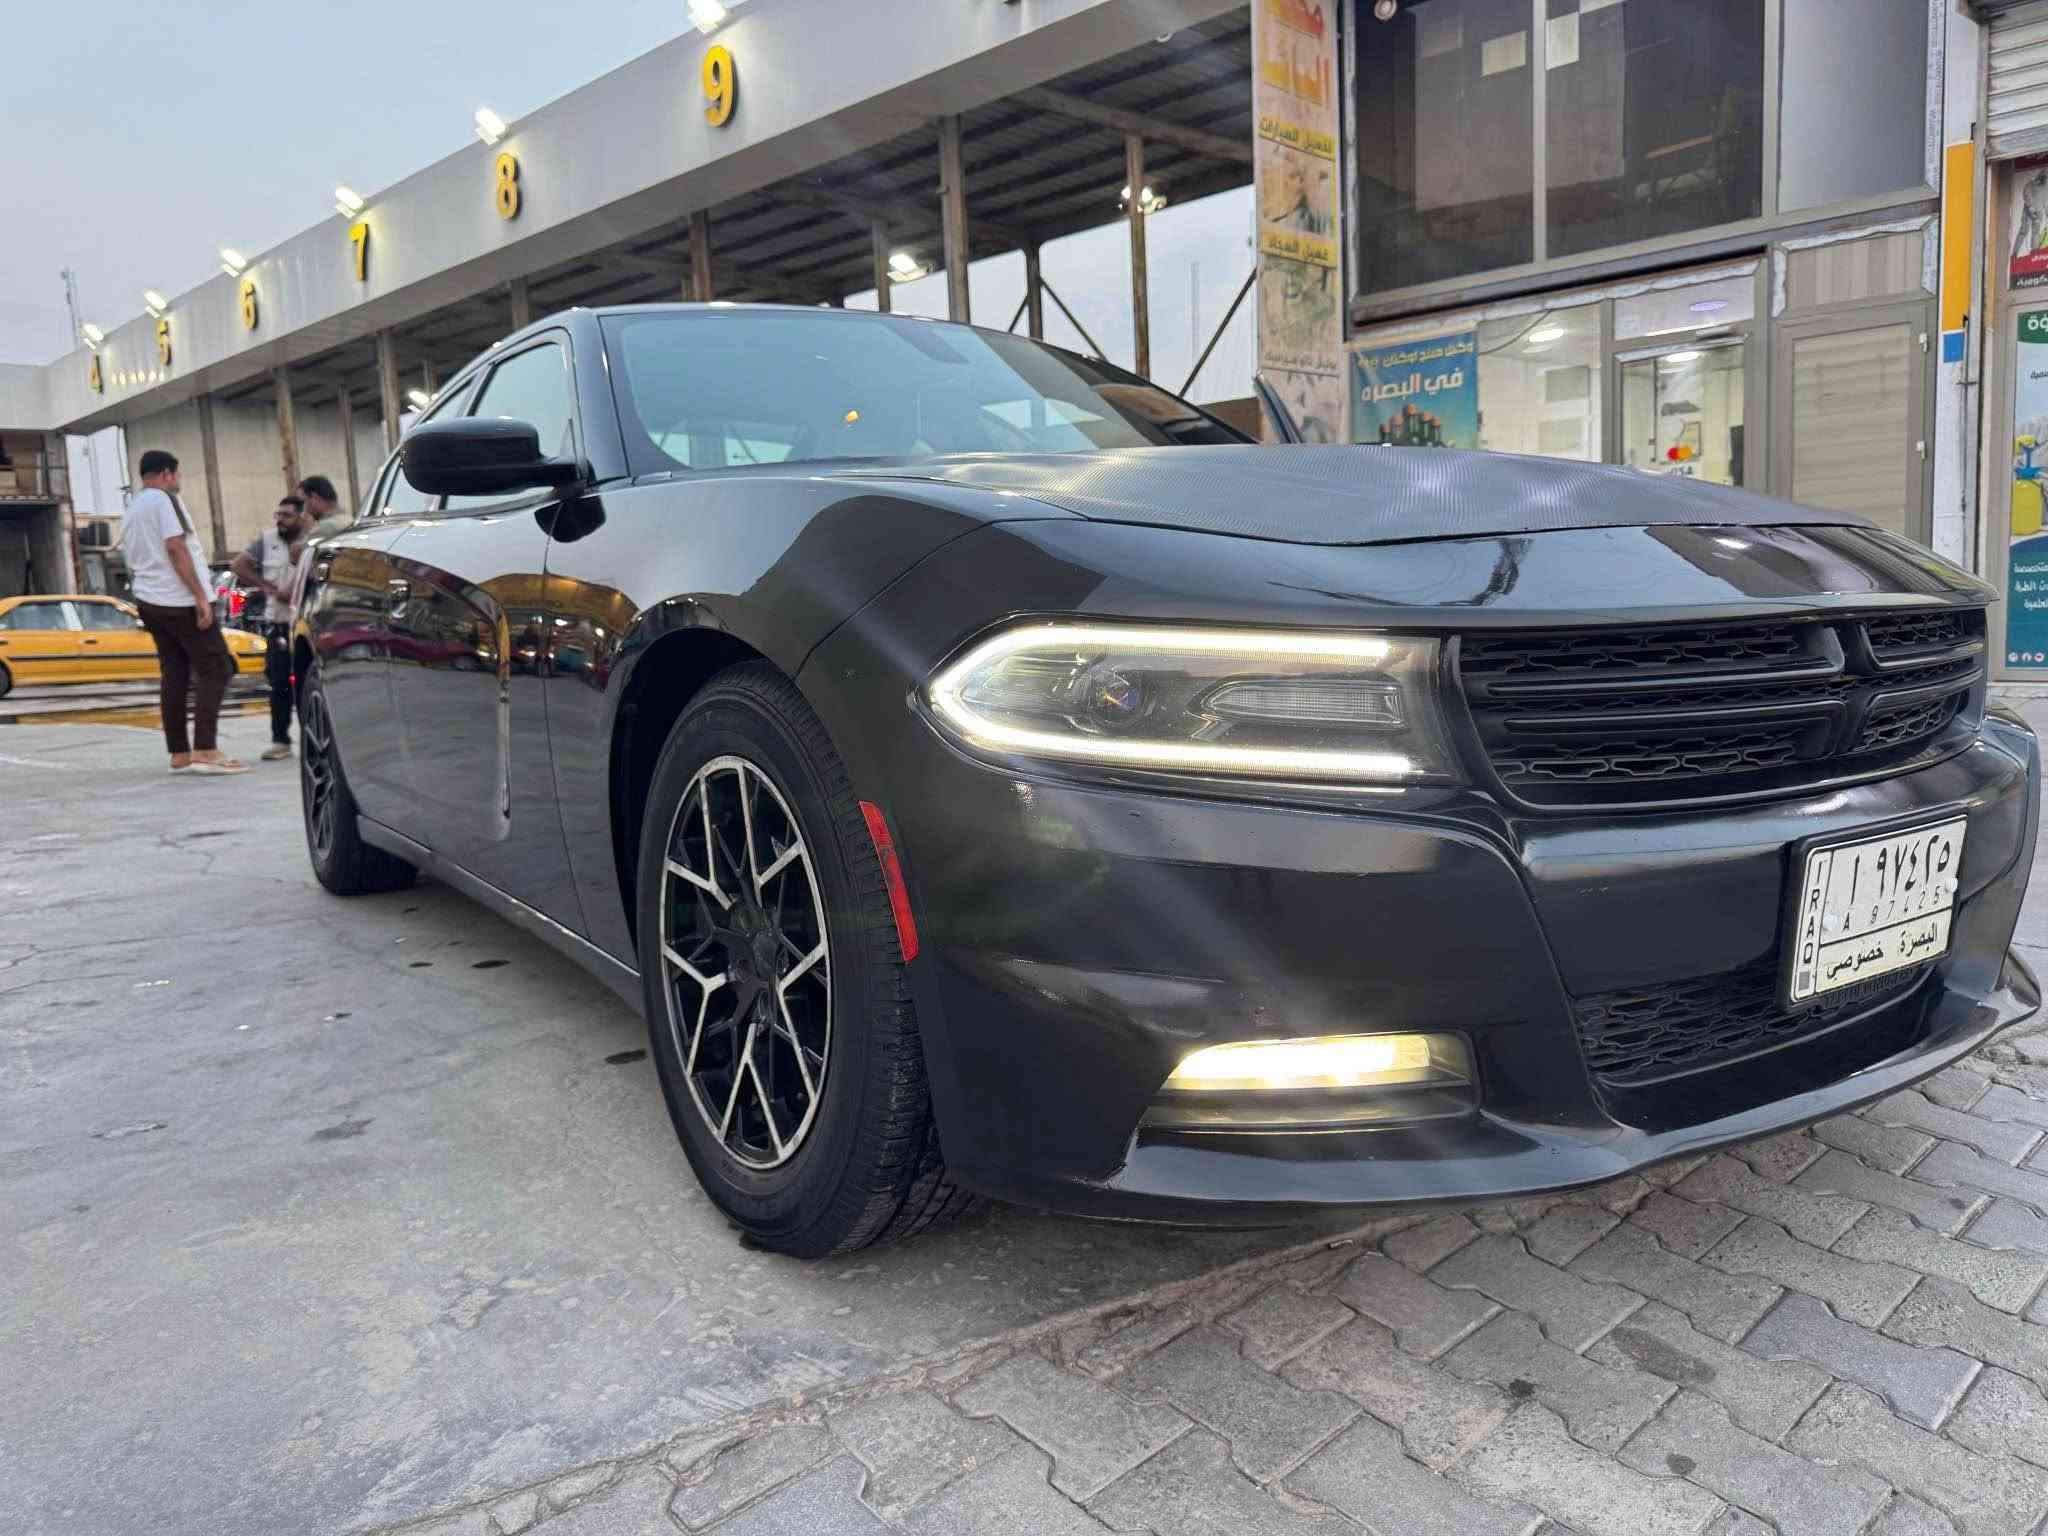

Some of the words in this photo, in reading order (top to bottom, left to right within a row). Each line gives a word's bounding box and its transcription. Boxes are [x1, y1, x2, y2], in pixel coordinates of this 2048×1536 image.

[703, 44, 737, 127] 9
[496, 152, 520, 219] 8
[349, 222, 370, 281] 7
[240, 279, 258, 330] 6
[156, 319, 171, 366] 5
[1361, 372, 1421, 403] البصره
[1424, 367, 1464, 396] في
[1876, 834, 1951, 899] ٩٧٤٢٥
[1802, 860, 1824, 964] IRAQ
[1842, 911, 1850, 931] A
[1826, 942, 1885, 981] خصوصي
[1897, 922, 1938, 957] البصرة
